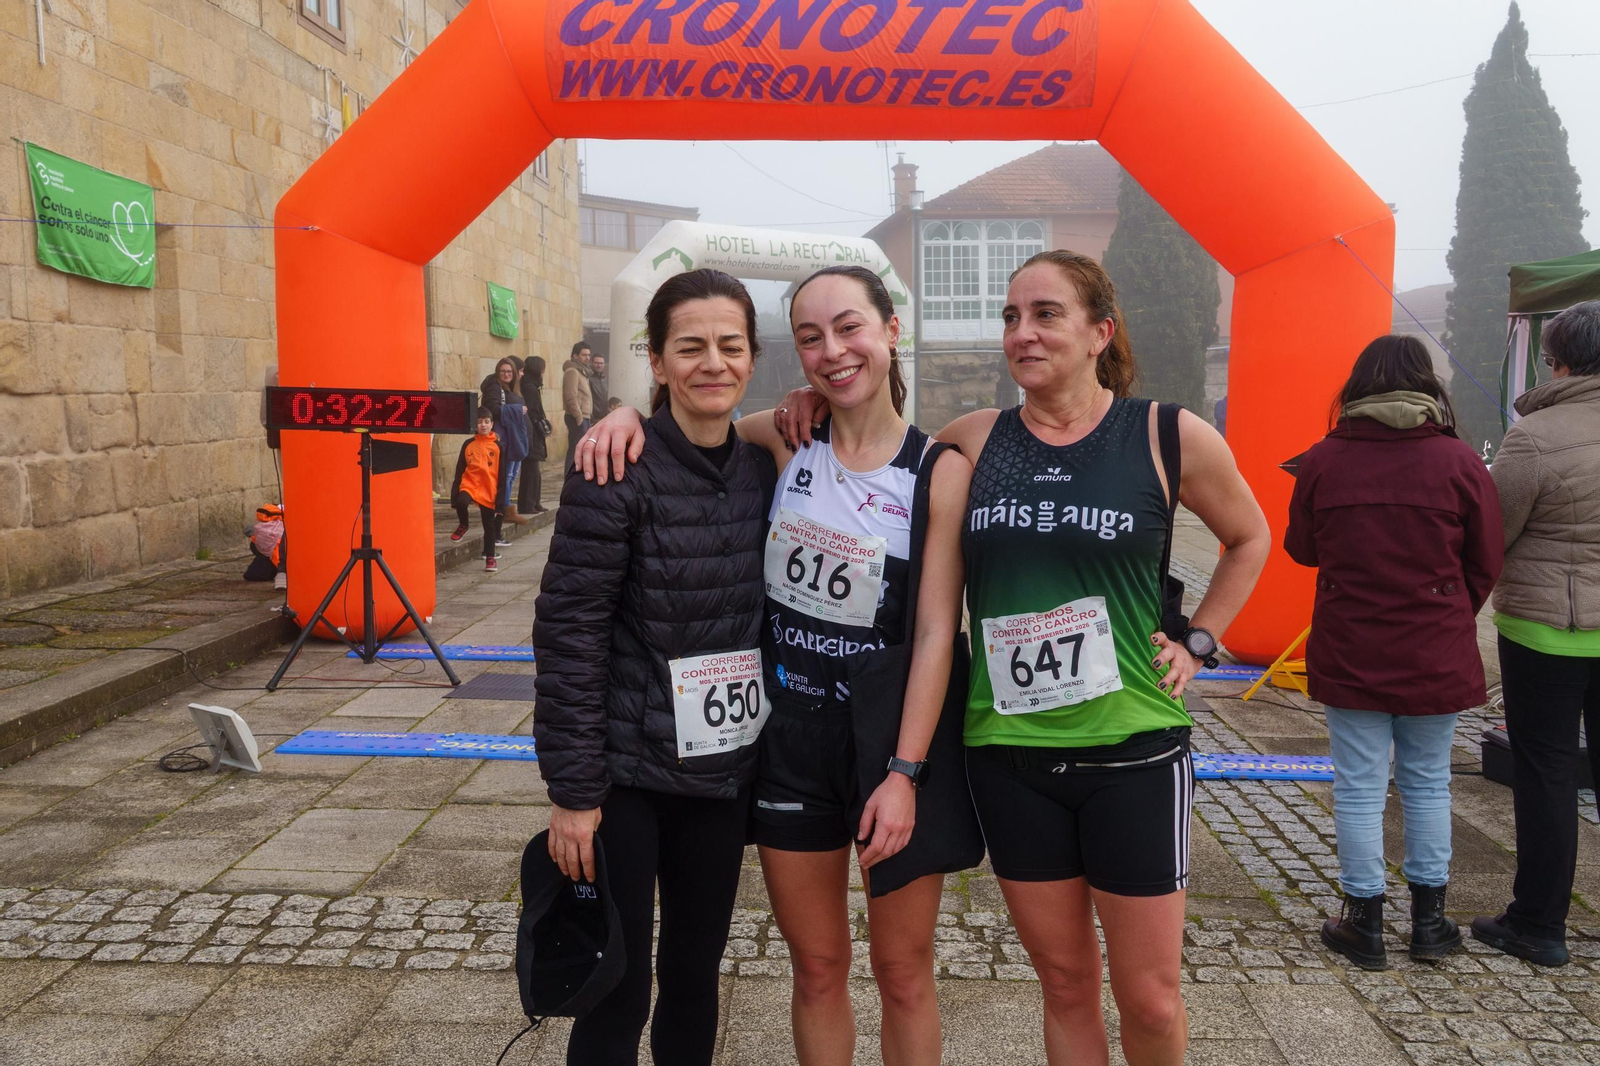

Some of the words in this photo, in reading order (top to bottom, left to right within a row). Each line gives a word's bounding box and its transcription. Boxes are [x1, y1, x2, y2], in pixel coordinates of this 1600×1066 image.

[561, 0, 1083, 57] CRONOTEC
[560, 58, 1073, 107] WWW.CRONOTEC.ES
[38, 213, 73, 233] soms
[705, 233, 760, 255] HOTEL
[769, 240, 788, 258] LA
[704, 256, 800, 272] www.hotelrectoral.com
[292, 393, 432, 427] 0:32:27
[1033, 474, 1072, 482] amura
[797, 518, 858, 546] CORREMOS
[970, 498, 1033, 532] máis
[1036, 501, 1058, 532] que
[1061, 505, 1134, 540] auga
[779, 521, 817, 542] CONTRA
[819, 536, 828, 545] O
[829, 540, 876, 558] CANCRO
[786, 545, 851, 601] 616
[992, 626, 1030, 639] CONTRA
[1032, 624, 1042, 633] O
[1044, 609, 1097, 630] CANCRO
[1006, 606, 1074, 628] CORREMOS
[1033, 630, 1064, 642] FEBREIRO
[1075, 622, 1090, 631] 2026
[681, 666, 728, 679] CONTRA
[730, 665, 737, 673] O
[701, 653, 756, 668] CORREMOS
[1010, 632, 1085, 688] 647
[786, 670, 808, 684] XUNTA
[1019, 688, 1038, 697] EMILIA
[1038, 685, 1055, 695] VIDAL
[1056, 679, 1085, 690] LORENZO
[703, 678, 760, 728] 650
